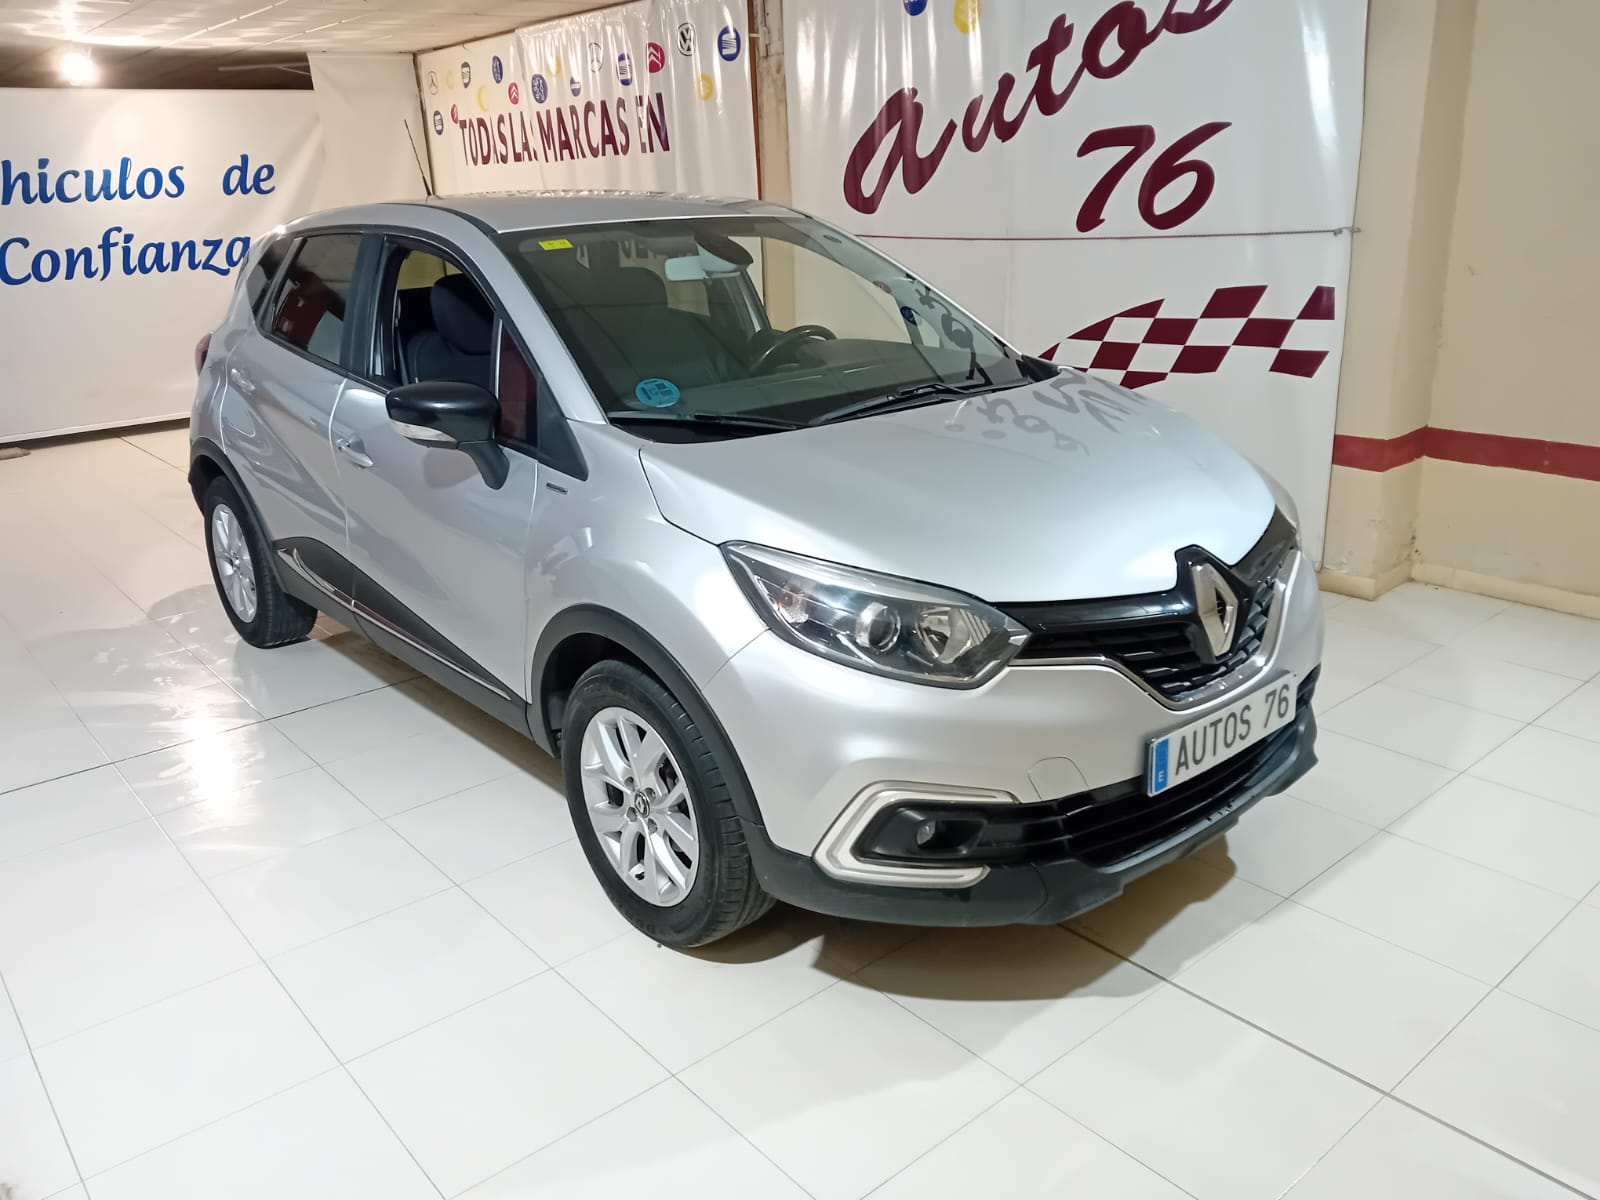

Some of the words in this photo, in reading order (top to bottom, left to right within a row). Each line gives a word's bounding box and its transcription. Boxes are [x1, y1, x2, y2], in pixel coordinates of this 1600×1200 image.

[536, 97, 630, 163] MARCAS
[635, 92, 670, 153] EN
[222, 154, 275, 196] de
[1076, 122, 1232, 233] 76
[0, 226, 251, 286] Confianza
[1175, 704, 1252, 776] AUTOS
[1263, 683, 1290, 729] 76
[1158, 770, 1165, 783] E
